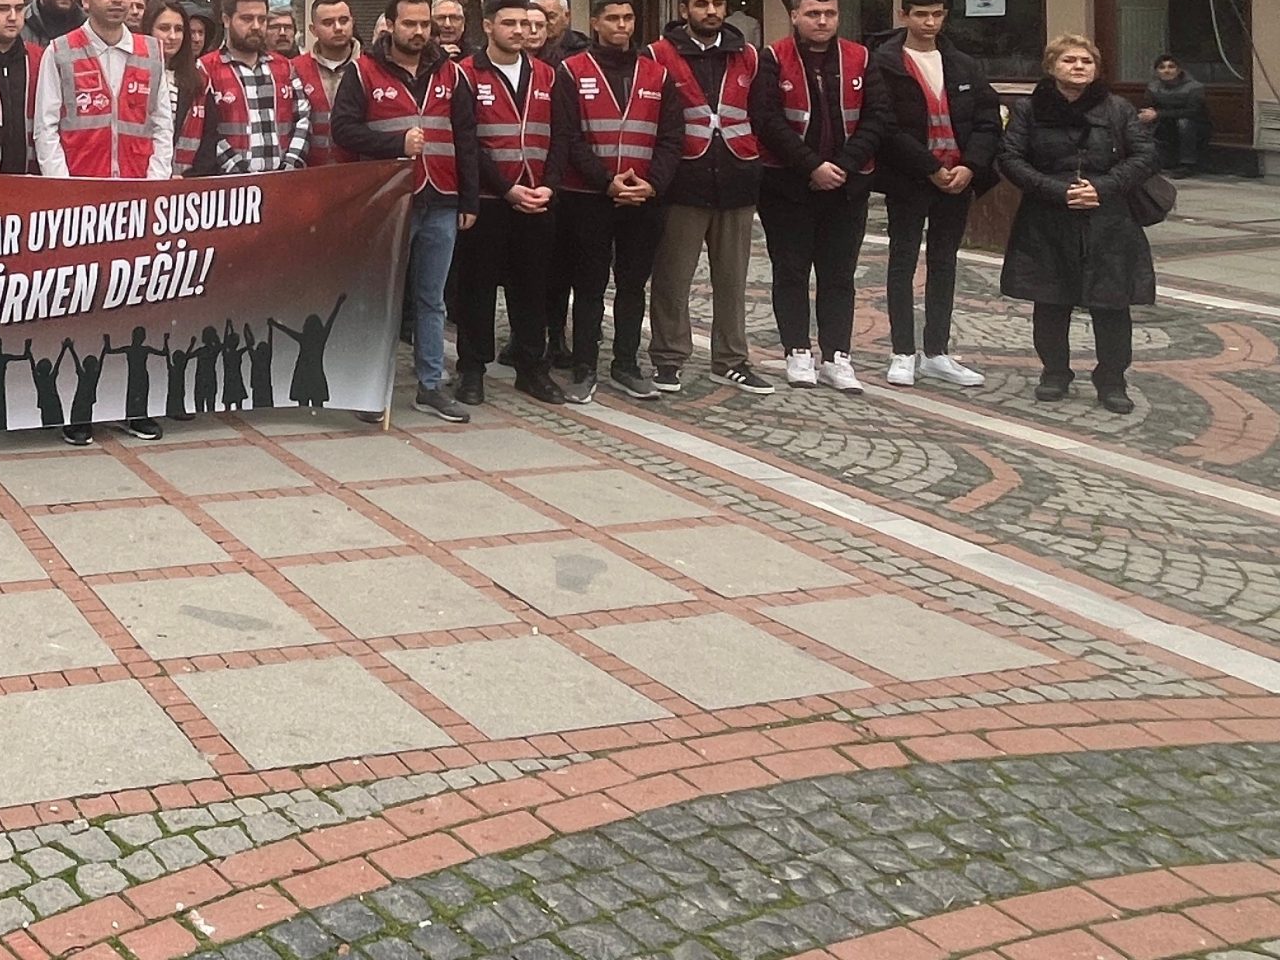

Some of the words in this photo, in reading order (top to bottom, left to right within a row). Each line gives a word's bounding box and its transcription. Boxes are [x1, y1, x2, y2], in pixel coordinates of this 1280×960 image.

[27, 197, 148, 252] UYURKEN
[152, 185, 262, 236] SUSULUR
[102, 238, 215, 309] DEĞİL!
